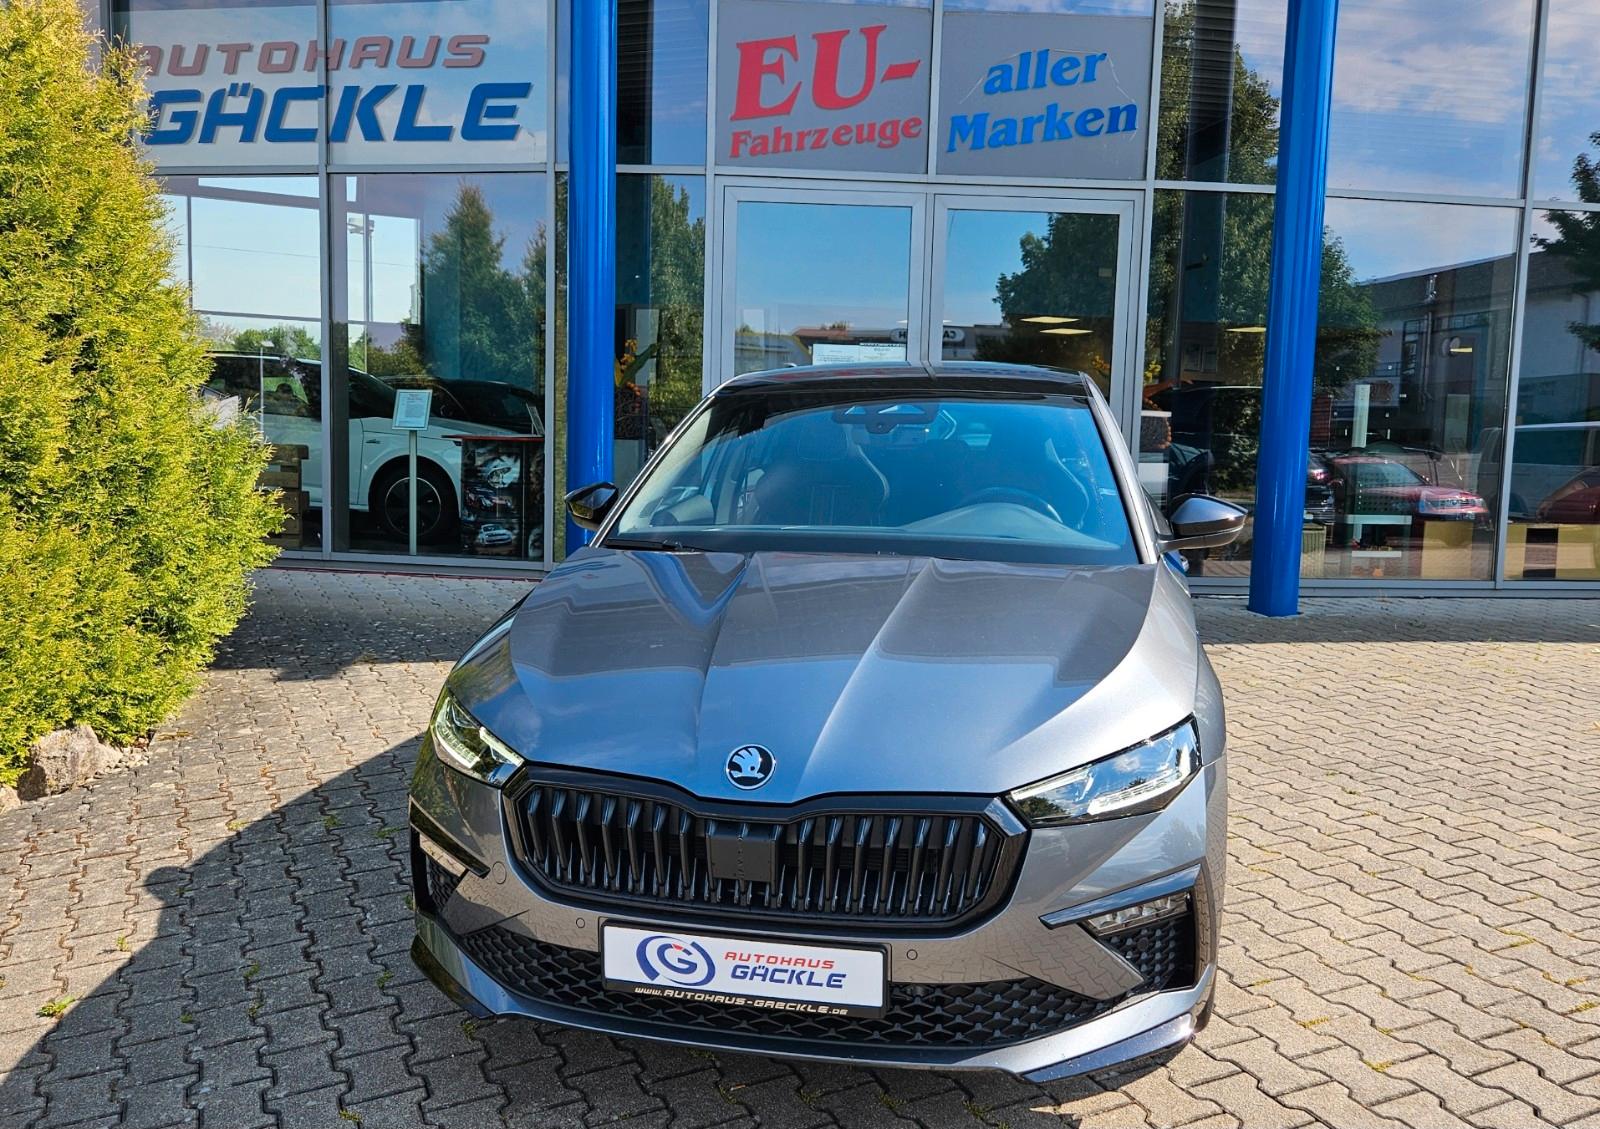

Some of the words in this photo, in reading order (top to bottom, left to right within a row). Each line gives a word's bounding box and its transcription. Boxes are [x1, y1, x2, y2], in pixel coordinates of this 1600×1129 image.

[729, 24, 921, 121] EU-
[983, 49, 1108, 96] aller
[143, 81, 533, 145] GÄCKLE
[946, 99, 1139, 154] Marken
[728, 117, 923, 159] Fahrzeuge
[724, 951, 835, 969] AUTOHAUS
[731, 964, 847, 989] GÄCKLE
